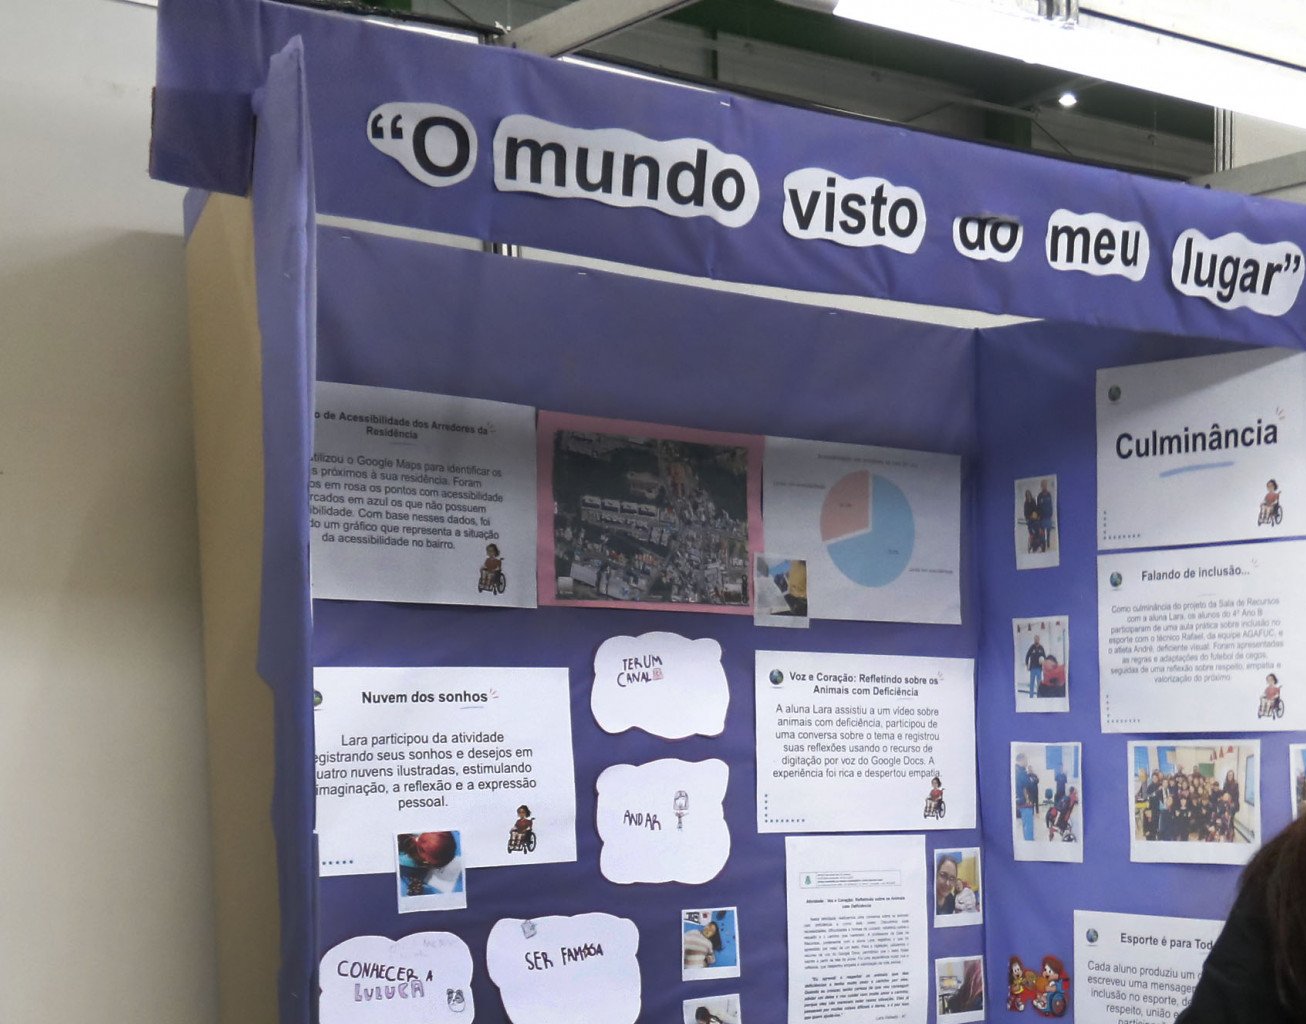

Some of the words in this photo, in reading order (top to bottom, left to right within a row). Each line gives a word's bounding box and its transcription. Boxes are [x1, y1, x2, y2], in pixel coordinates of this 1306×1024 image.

[504, 135, 746, 213] mundo
[787, 177, 918, 239] visto
[1049, 223, 1140, 268] meu
[323, 410, 337, 420] de
[410, 418, 428, 429] dos
[430, 421, 476, 433] Arredores
[477, 425, 488, 434] da
[1115, 418, 1279, 460] Culminância
[1141, 569, 1181, 581] Falando
[1183, 568, 1196, 579] de
[616, 671, 652, 688] CANAL
[789, 672, 806, 681] Voz
[857, 674, 902, 684] Refletindo
[903, 675, 927, 684] sobre
[362, 692, 408, 704] Nuvem
[410, 691, 436, 703] dos
[438, 690, 488, 703] sonhos
[813, 686, 850, 695] Animais
[776, 705, 784, 713] A
[785, 704, 810, 714] aluna
[811, 705, 832, 714] Lara
[834, 705, 867, 715] assistiu
[916, 706, 939, 716] sobre
[777, 717, 812, 727] animais
[884, 719, 926, 730] participou
[927, 719, 938, 728] de
[341, 735, 368, 746] Lara
[370, 733, 429, 748] participou
[431, 732, 448, 744] da
[450, 731, 504, 744] atividade
[314, 750, 374, 765] egistrando
[376, 752, 406, 761] seus
[408, 748, 452, 760] sonhos
[455, 750, 464, 759] e
[466, 746, 512, 761] desejos
[514, 748, 533, 758] em
[781, 755, 822, 767] digitação
[823, 757, 838, 767] por
[857, 755, 868, 764] do
[870, 755, 901, 767] Google
[902, 756, 927, 765] Docs.
[928, 756, 935, 764] A
[317, 768, 348, 780] uatro
[350, 768, 394, 778] nuvens
[396, 764, 458, 777] ilustradas,
[460, 761, 532, 775] estimulando
[316, 782, 389, 798] imaginação,
[392, 784, 401, 793] a
[403, 780, 452, 792] reflexão
[454, 782, 463, 791] e
[466, 781, 474, 790] a
[477, 777, 537, 792] expressão
[398, 795, 448, 811] pessoal.
[1120, 933, 1159, 947] Esporte
[1160, 936, 1167, 946] é
[1169, 939, 1192, 950] para
[1193, 939, 1213, 950] Tod
[524, 951, 554, 971] SER
[1087, 960, 1111, 972] Cada
[1112, 963, 1138, 975] aluno
[1139, 966, 1178, 978] produziu
[1180, 970, 1195, 979] um
[336, 959, 418, 982] CONHECER
[425, 970, 434, 982] A
[1087, 975, 1127, 987] escreveu
[1128, 979, 1149, 989] uma
[1090, 987, 1127, 1000] inclusão
[1128, 993, 1140, 1002] no
[1142, 994, 1178, 1007] esporte,
[1106, 1004, 1144, 1017] respeito,
[1145, 1007, 1171, 1018] união
